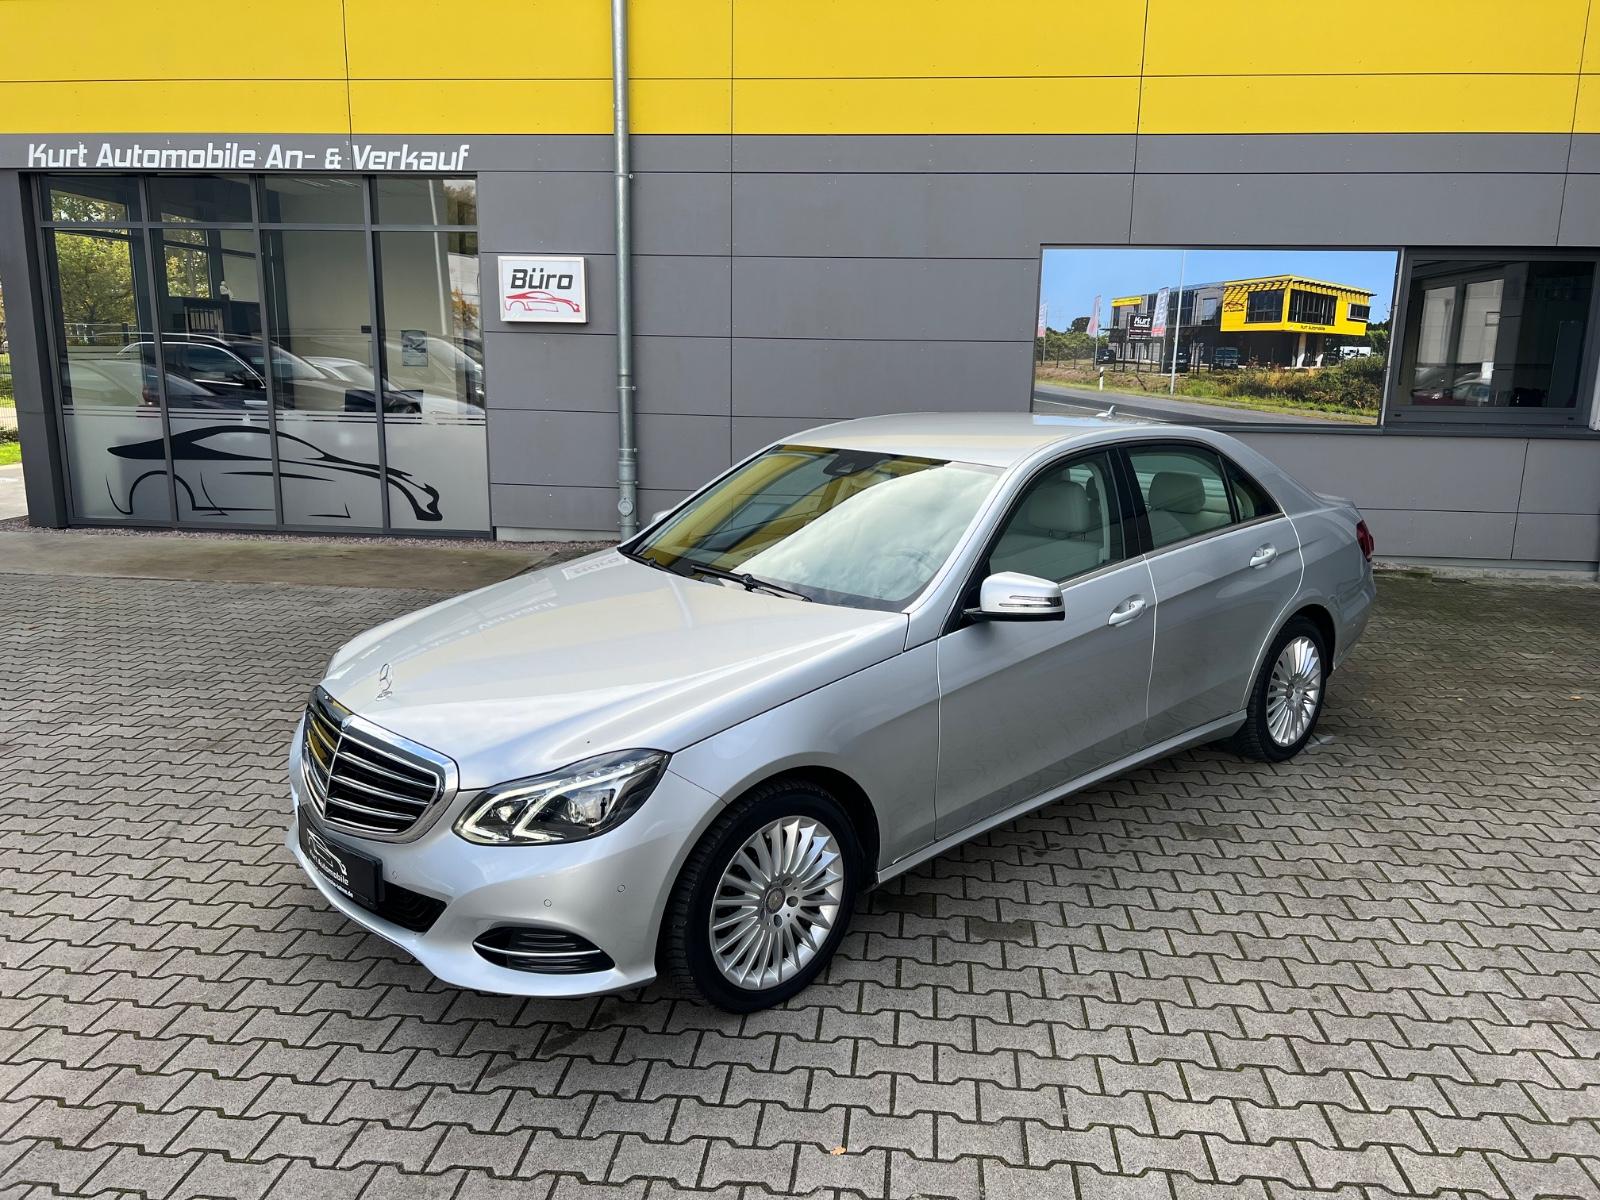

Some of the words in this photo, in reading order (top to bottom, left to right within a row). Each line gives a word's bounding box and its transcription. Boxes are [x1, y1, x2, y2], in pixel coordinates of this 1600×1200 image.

[27, 143, 87, 168] Kurt
[95, 142, 256, 169] Automobile
[264, 143, 316, 169] An-
[324, 147, 343, 170] &
[353, 144, 470, 171] Verkauf
[510, 267, 574, 290] Büro
[1133, 316, 1151, 326] Kurt
